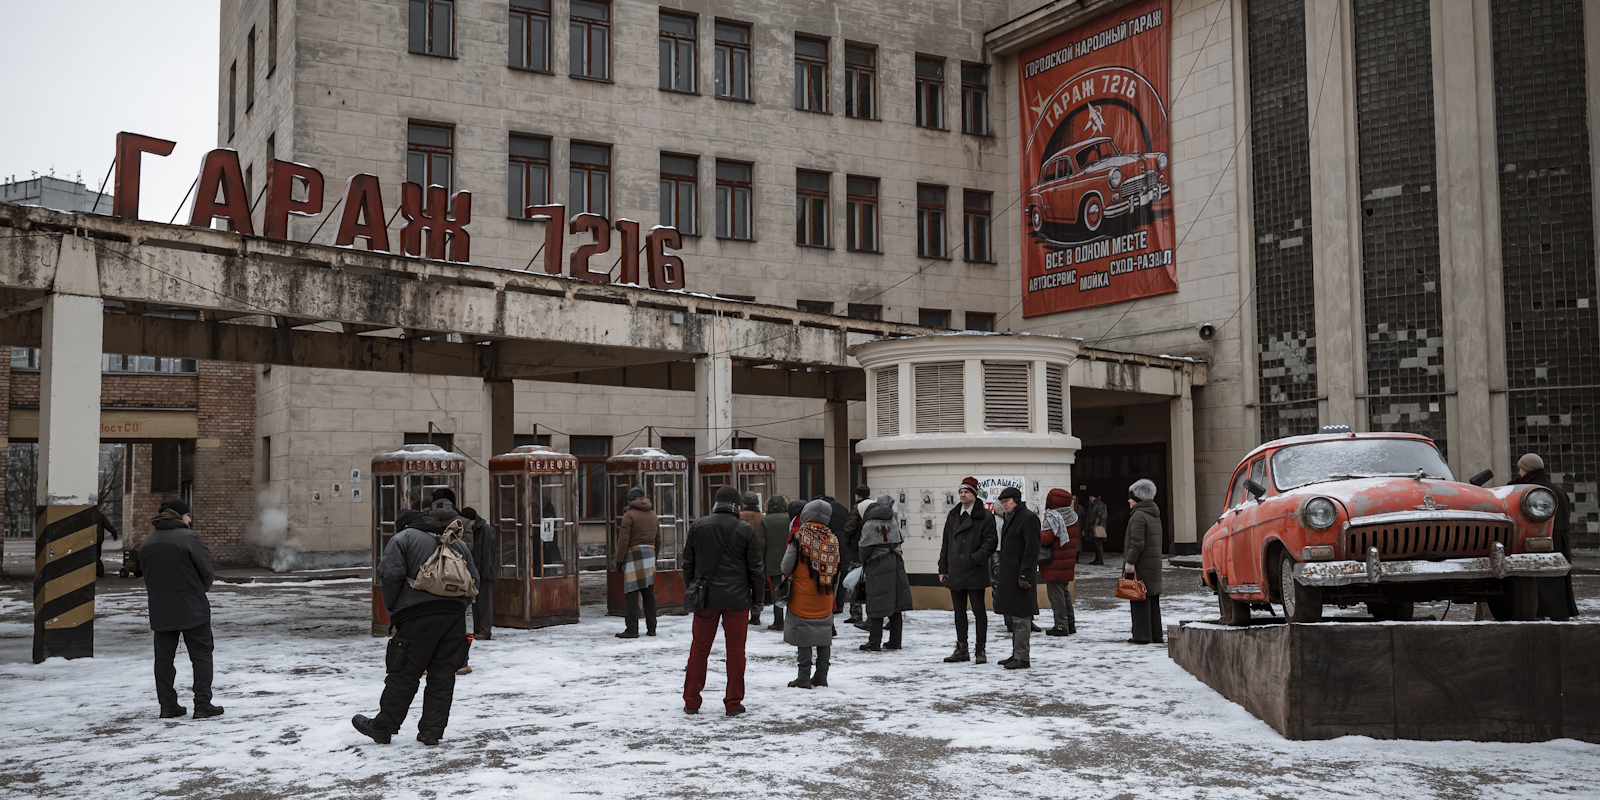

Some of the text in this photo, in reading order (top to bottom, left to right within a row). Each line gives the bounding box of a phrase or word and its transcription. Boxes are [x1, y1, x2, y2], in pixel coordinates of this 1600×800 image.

[1025, 8, 1162, 79] ГОРОДСКОЙ НАРОДНЫЙ ГАРАЖ
[1045, 75, 1137, 128] ГАРАЖ 7216
[112, 131, 685, 290] ГАРАЖ 7216
[1045, 230, 1148, 270] ВСЕ В ОДНОМ МЕСТЕ
[1029, 249, 1173, 292] АВТОСЕРВИС МОЙКА СХОД-РАЗВАЛ
[408, 460, 464, 470] ТЕЛЕФОН
[529, 460, 577, 470] ТЕЛЕФОН
[642, 460, 686, 470] ТЕЛЕФОН
[738, 462, 776, 472] ТЕЛЕФОН
[978, 478, 1021, 490] РИГЛАШАЕМ
